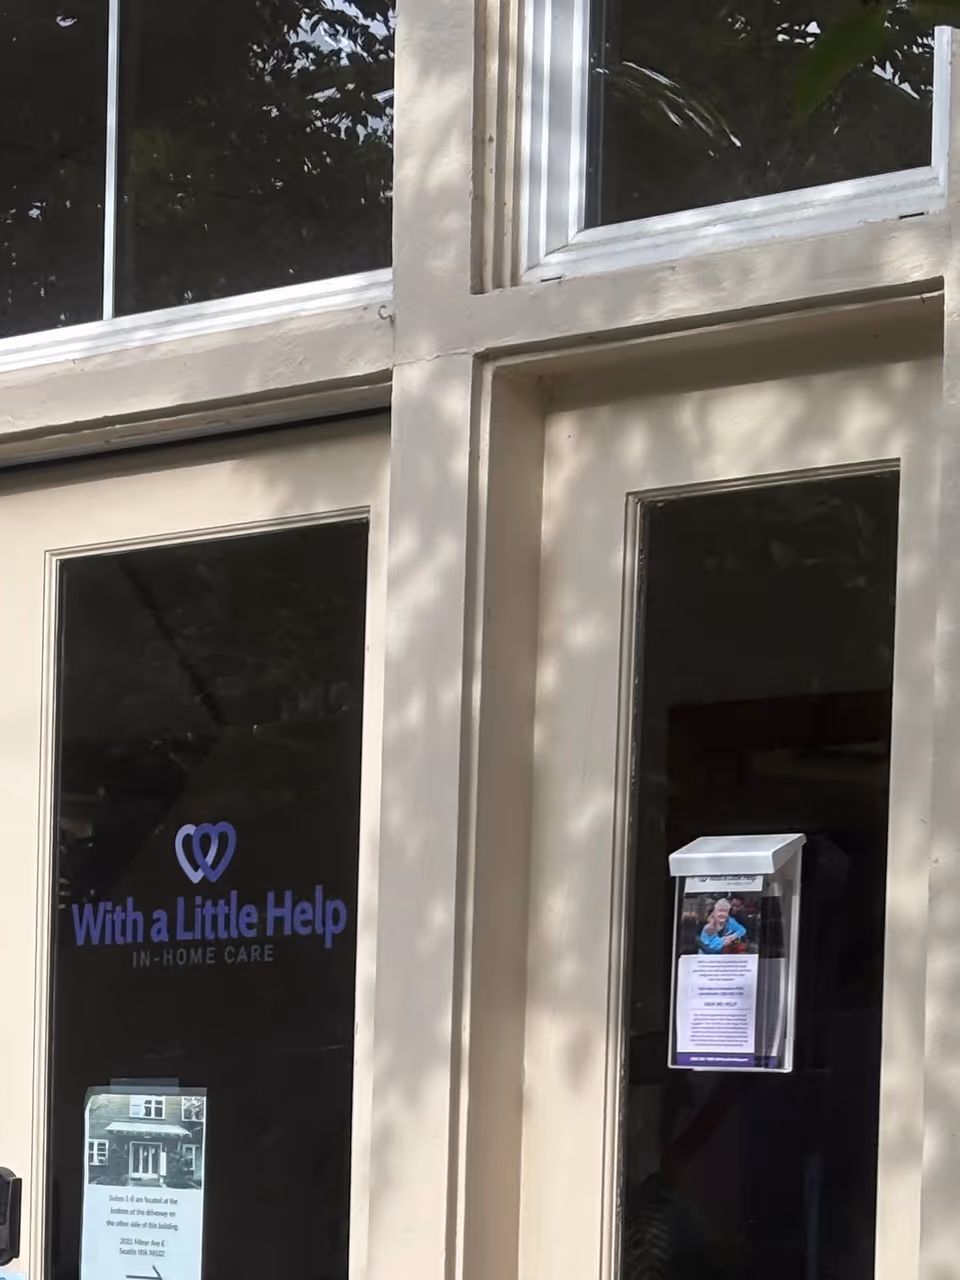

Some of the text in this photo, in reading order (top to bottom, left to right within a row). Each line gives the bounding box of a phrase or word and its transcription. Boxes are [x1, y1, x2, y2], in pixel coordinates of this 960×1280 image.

[71, 884, 347, 948] With a Little Help
[132, 944, 274, 968] IN-HOME CARE
